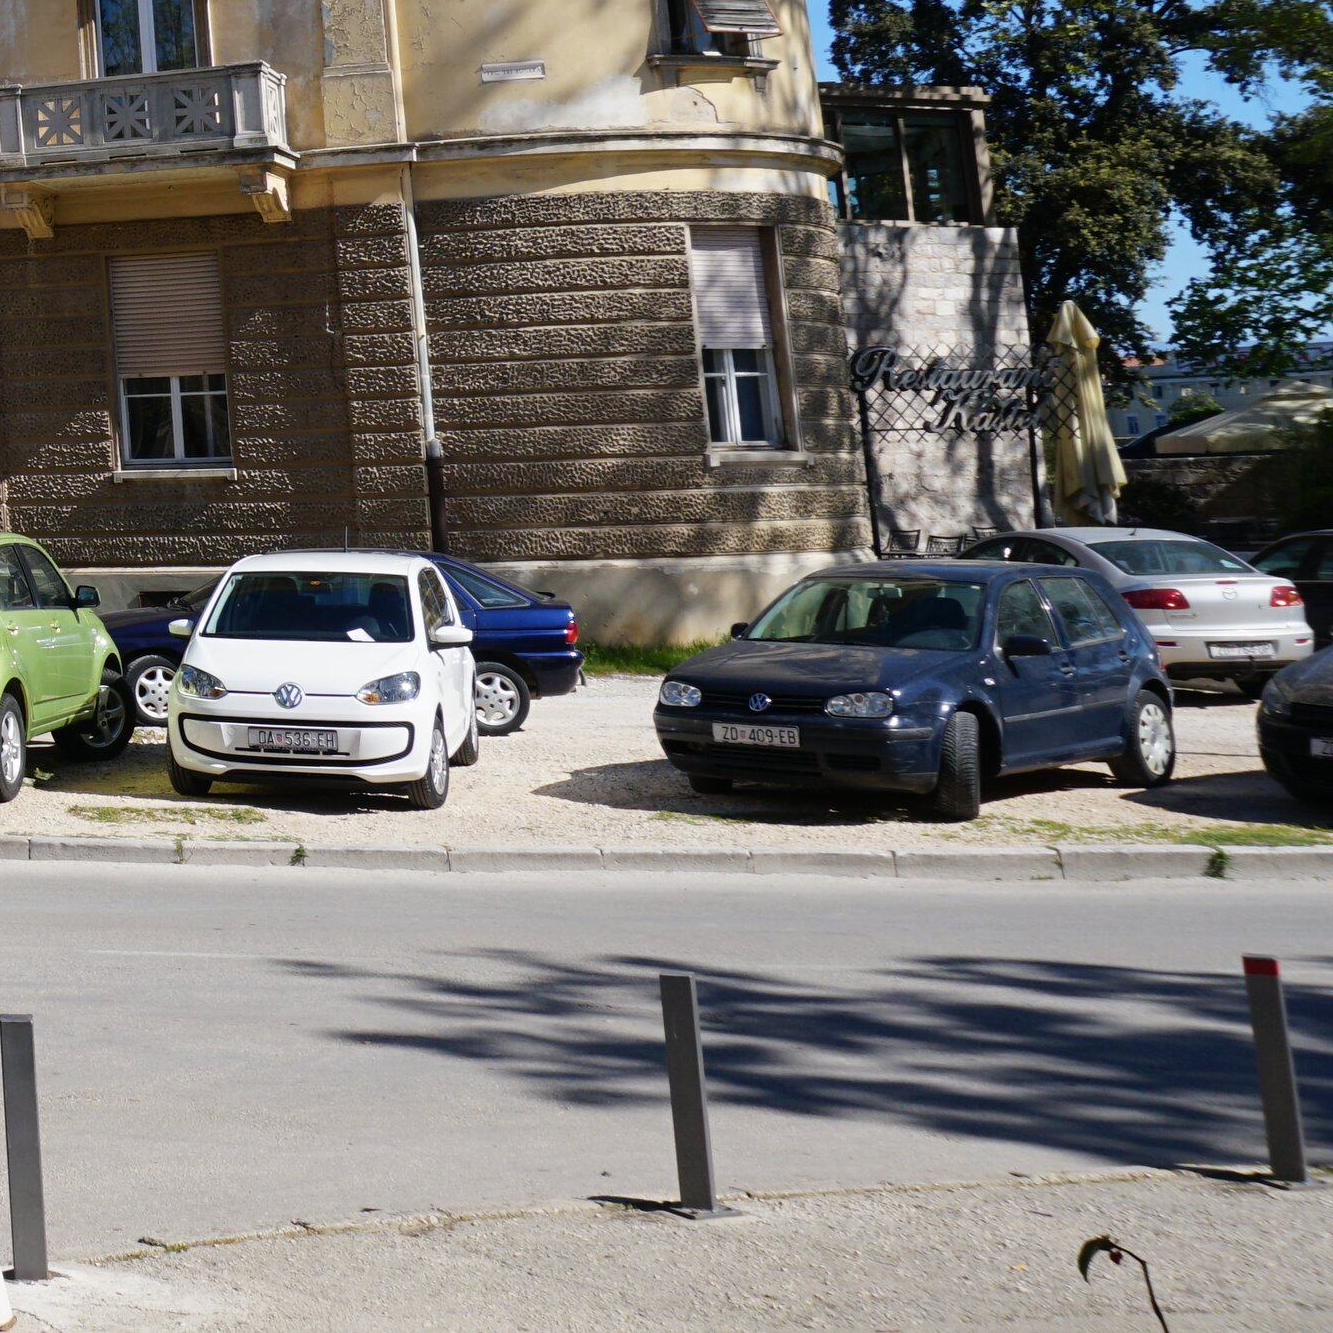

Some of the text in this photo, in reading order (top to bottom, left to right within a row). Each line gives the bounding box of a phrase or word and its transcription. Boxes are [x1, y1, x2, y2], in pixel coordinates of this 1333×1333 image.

[851, 346, 1062, 391] Restaurant
[258, 731, 334, 747] DA 536-EH
[722, 727, 796, 744] ZD 409-EB
